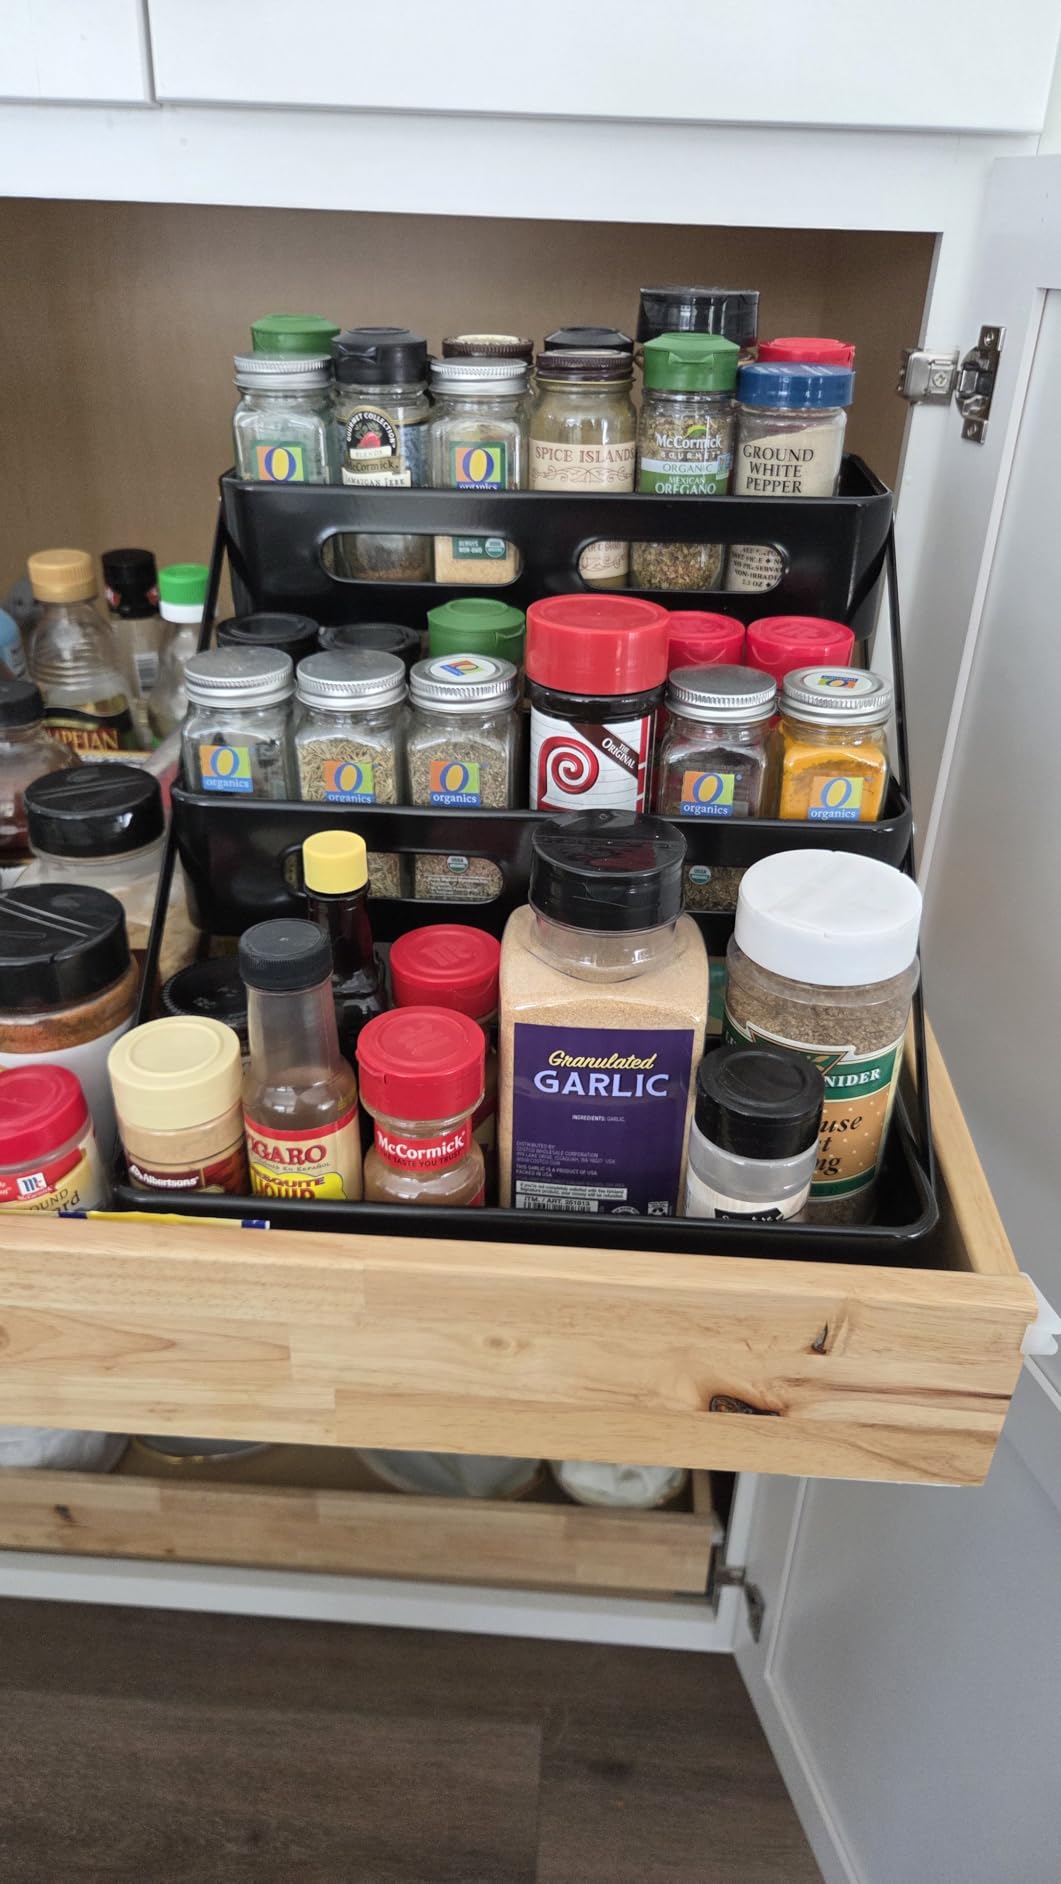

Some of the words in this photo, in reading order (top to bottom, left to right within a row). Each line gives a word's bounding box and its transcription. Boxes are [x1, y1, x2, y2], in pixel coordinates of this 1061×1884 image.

[363, 412, 395, 443] COLLECTION
[655, 431, 721, 449] McCormick
[535, 446, 573, 462] SPICE
[743, 444, 814, 462] GROUND
[662, 463, 714, 474] ORGANIC
[749, 461, 803, 478] WHITE
[655, 482, 717, 495] OREGANO
[669, 475, 706, 485] MEXICAN
[746, 476, 802, 494] PEPPER
[601, 738, 636, 769] ORIGINAL
[205, 778, 249, 790] organics
[328, 793, 372, 803] organics
[432, 793, 477, 805] organics
[683, 804, 728, 816] organics
[810, 808, 856, 820] organics
[548, 1050, 657, 1070] Granulated
[533, 1070, 669, 1097] GARLIC
[823, 1068, 880, 1087] NIDER
[377, 1131, 463, 1160] McCormick
[394, 1157, 417, 1167] TASTE
[420, 1160, 437, 1168] YOU
[440, 1151, 461, 1164] TRUST
